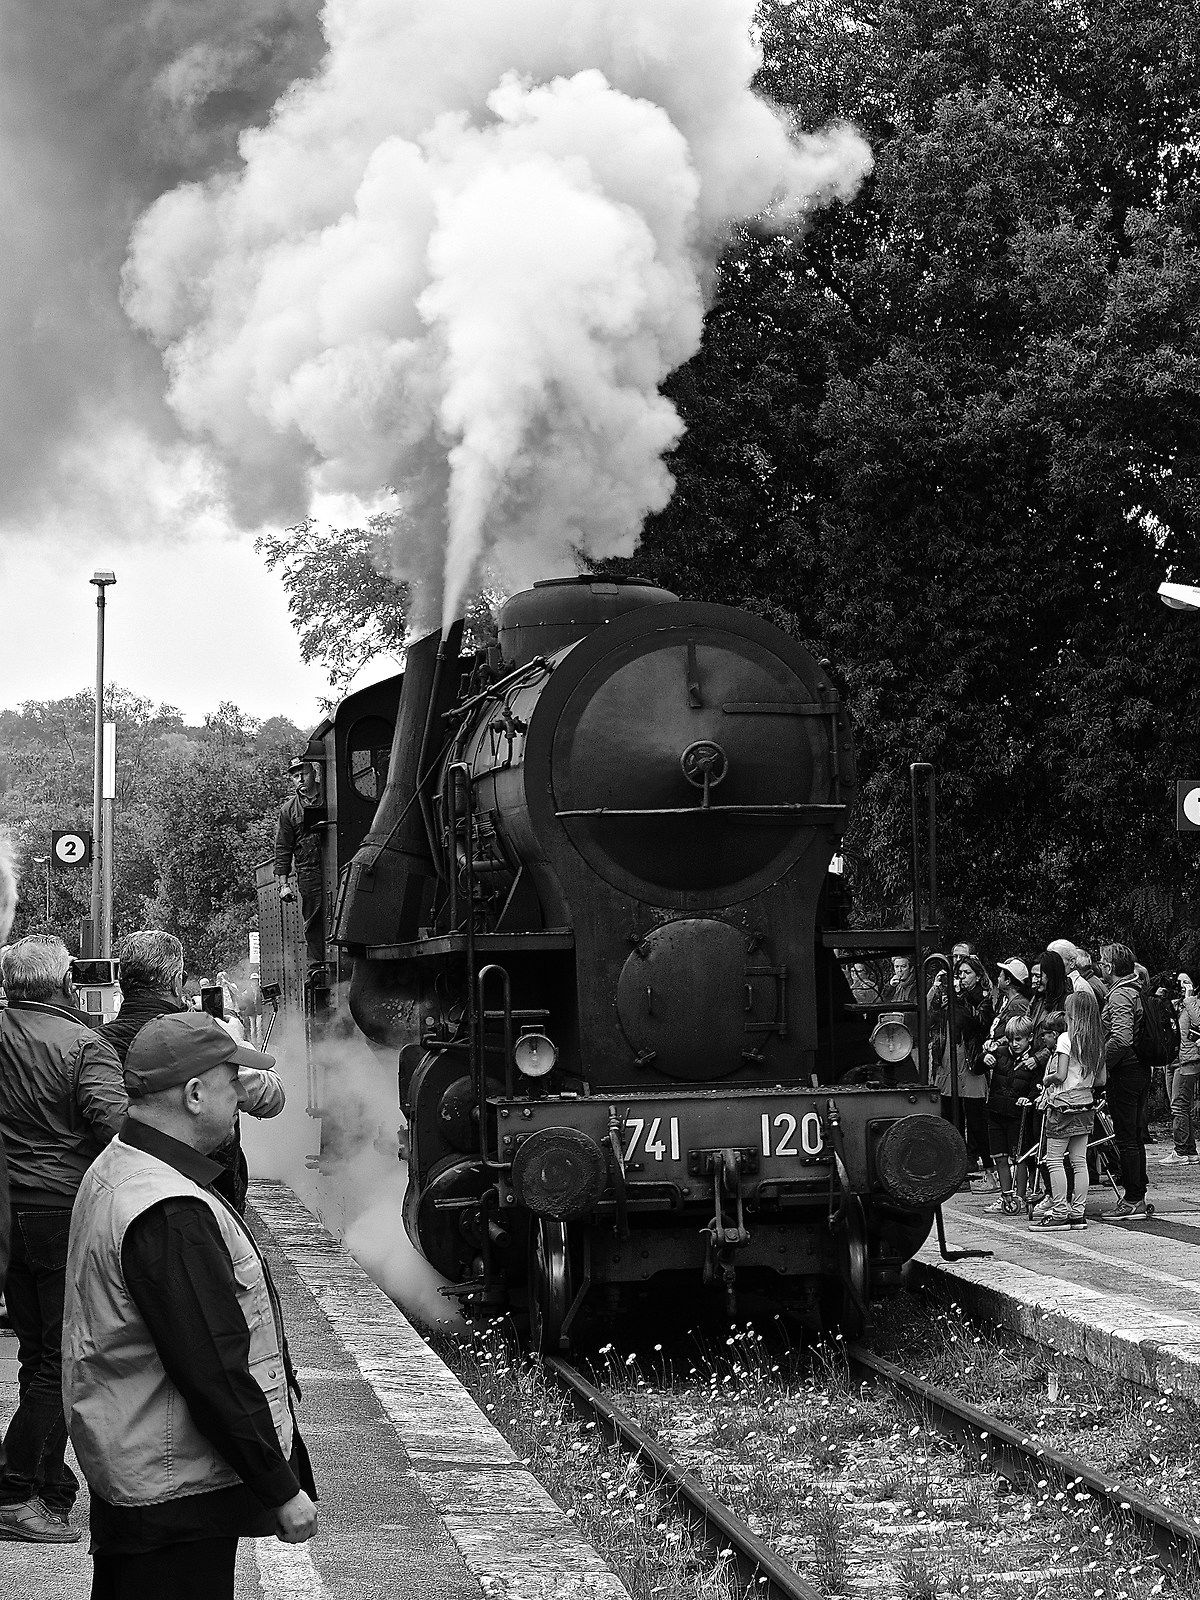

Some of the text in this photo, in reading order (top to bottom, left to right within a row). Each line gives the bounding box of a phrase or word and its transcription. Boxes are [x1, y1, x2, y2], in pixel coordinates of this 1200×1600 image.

[64, 840, 77, 856] 2
[623, 1111, 824, 1162] 741 120
